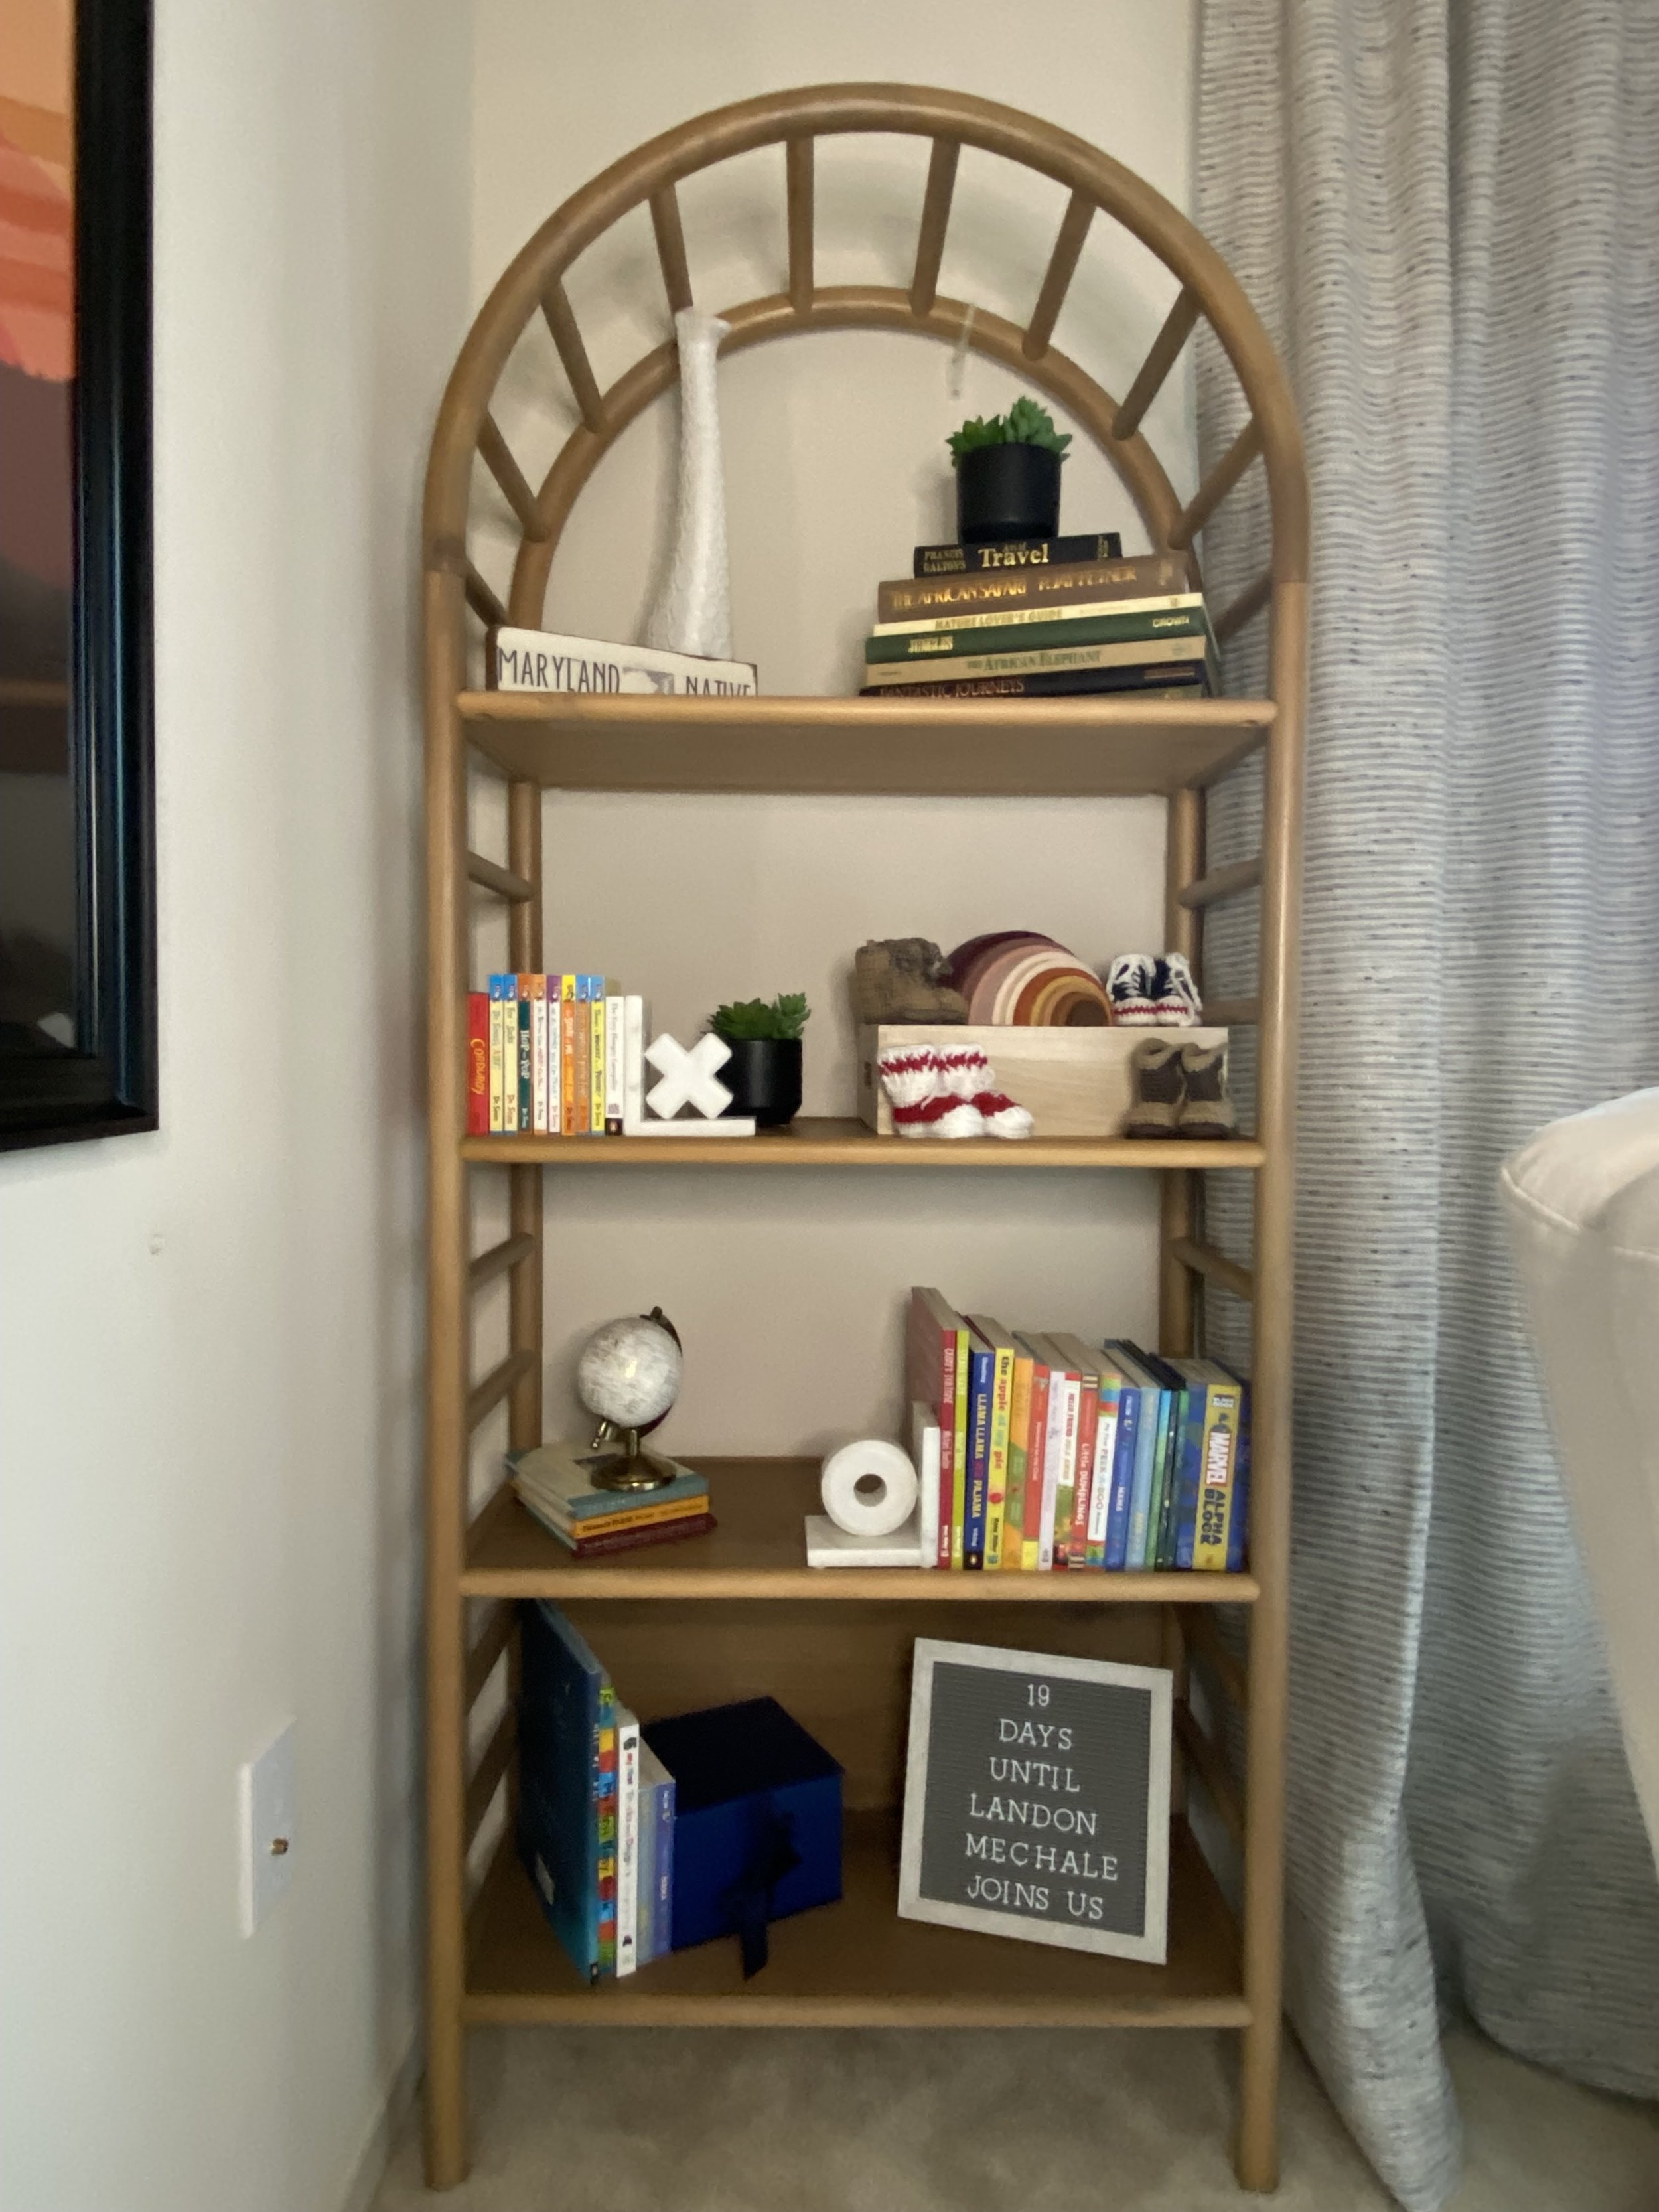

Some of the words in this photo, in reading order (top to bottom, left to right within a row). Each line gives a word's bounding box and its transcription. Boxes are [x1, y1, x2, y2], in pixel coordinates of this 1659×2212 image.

[978, 543, 1049, 568] Travel
[498, 647, 620, 694] MARYLAND
[520, 1029, 530, 1051] HOP
[470, 1038, 486, 1096] CORDUROY
[520, 1059, 530, 1080] POP
[1000, 1355, 1009, 1376] the
[976, 1394, 988, 1426] LLAMA
[997, 1378, 1008, 1412] apple
[974, 1427, 986, 1459] LLAMA
[994, 1450, 1005, 1470] pie
[1080, 1443, 1091, 1469] Little
[1206, 1432, 1230, 1485] MARVEL
[972, 1480, 983, 1518] PAJAMA
[1076, 1470, 1088, 1526] DUMPLINGS
[1200, 1488, 1216, 1545] BLOCK
[1211, 1489, 1226, 1545] ALPHA
[1027, 1684, 1050, 1708] 19
[999, 1718, 1073, 1751] DAYS
[989, 1756, 1080, 1793] UNTIL
[969, 1793, 1098, 1836] LANDON
[965, 1832, 1119, 1881] MECHALE
[967, 1875, 1049, 1911] JOINS
[1067, 1889, 1104, 1921] US
